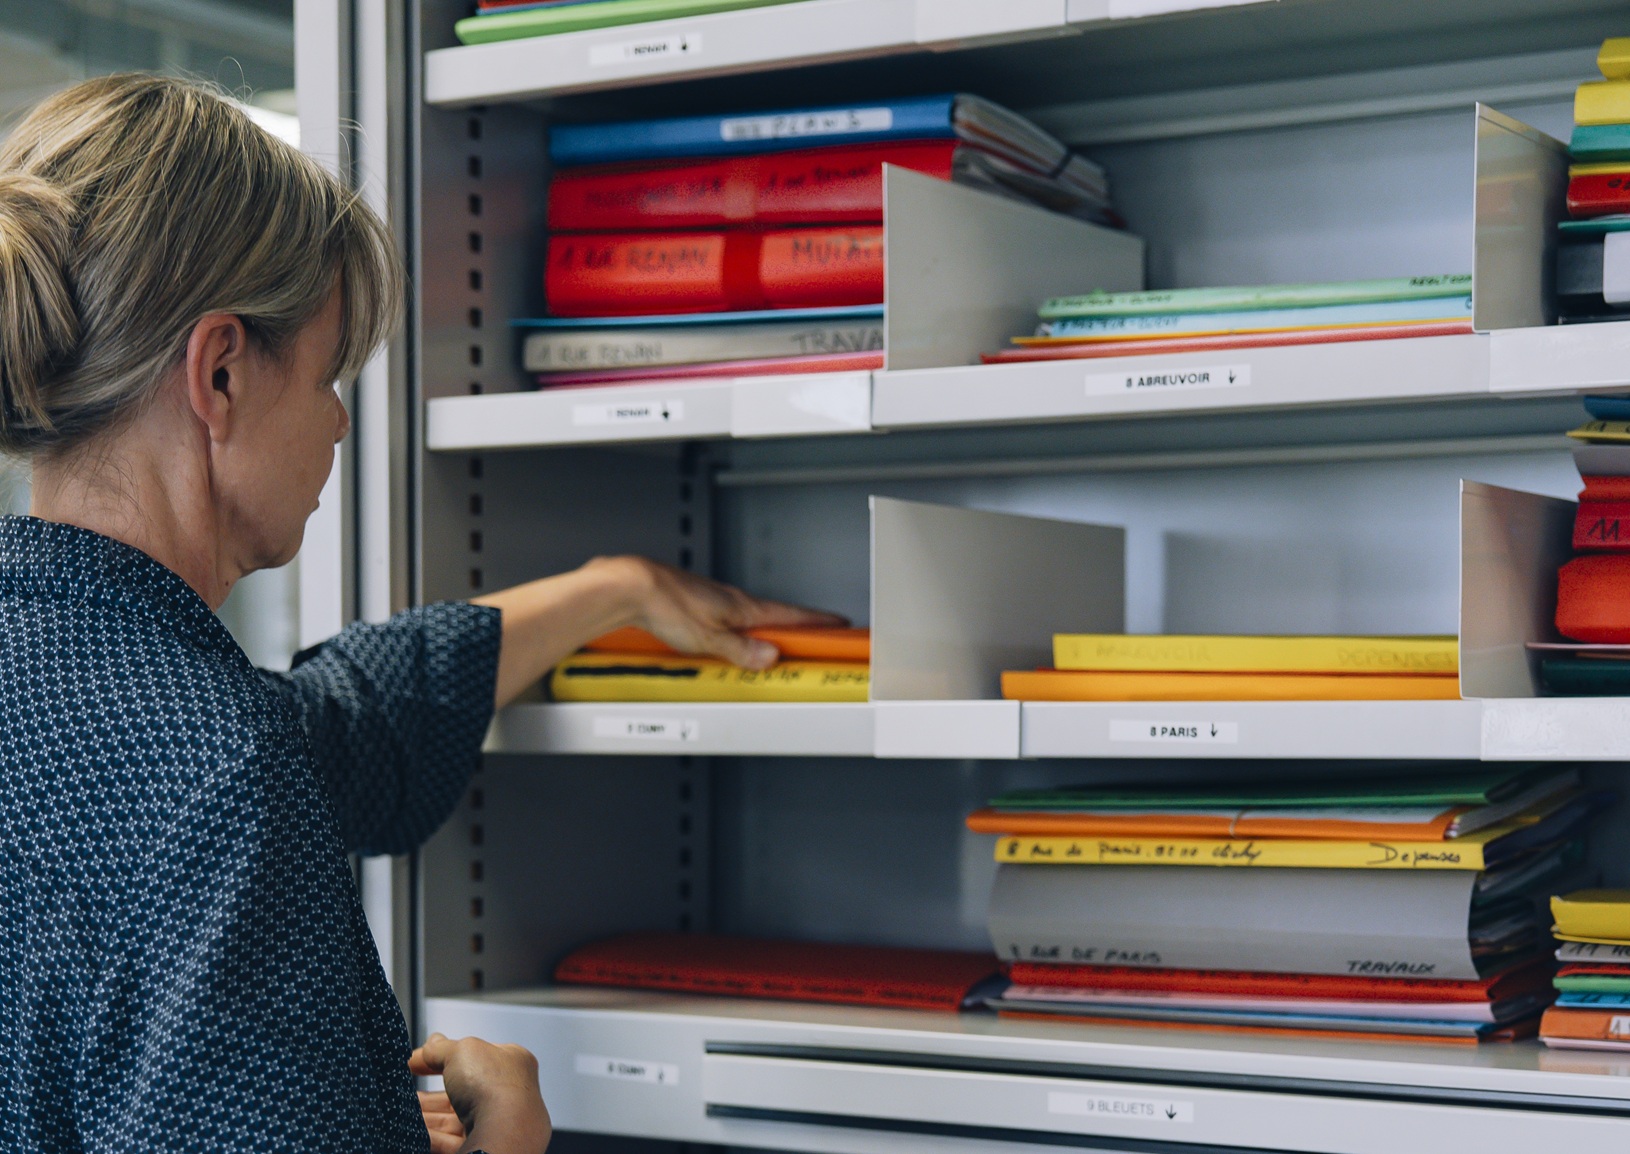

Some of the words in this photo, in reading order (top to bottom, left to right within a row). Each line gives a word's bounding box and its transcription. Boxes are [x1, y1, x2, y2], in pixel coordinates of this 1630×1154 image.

[1138, 371, 1210, 388] ABREUVOIR
[1149, 726, 1157, 737] 8
[1161, 726, 1199, 738] PARIS
[1030, 944, 1060, 959] RUE
[1071, 945, 1098, 961] DE
[1103, 948, 1162, 964] PARIS
[1346, 959, 1437, 975] TRAVAUX
[1086, 1099, 1095, 1111] 9
[1097, 1100, 1155, 1116] BLEUETS
